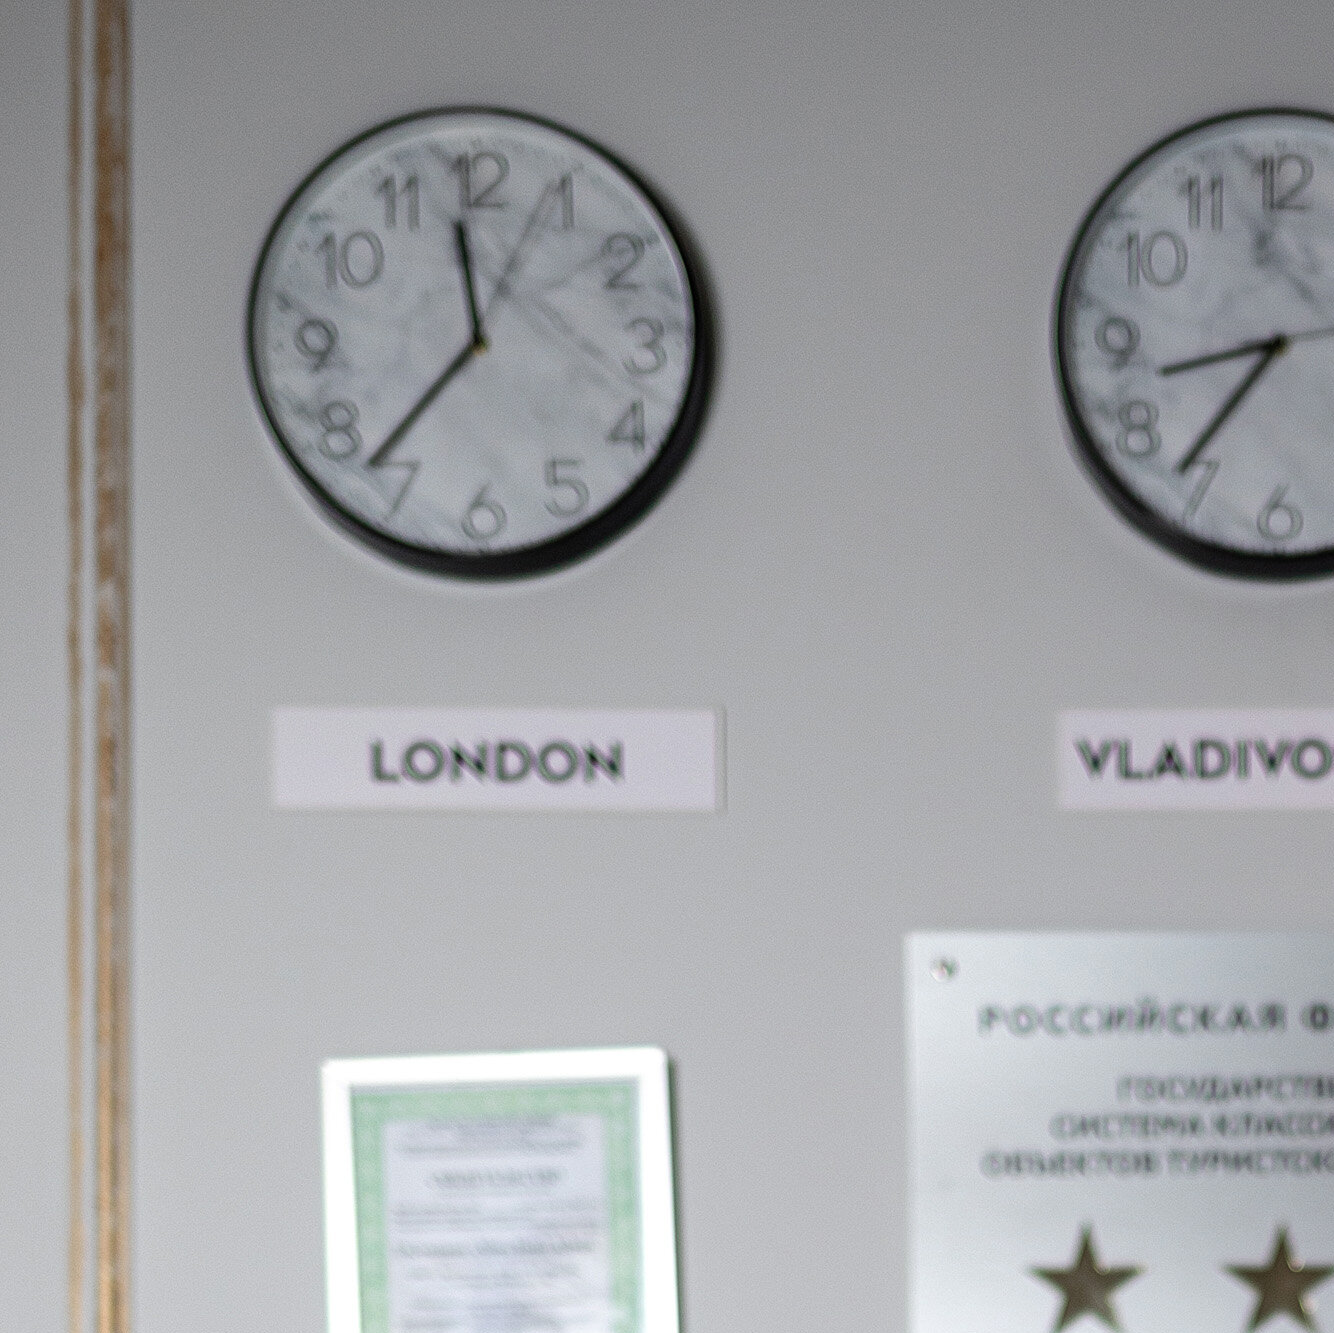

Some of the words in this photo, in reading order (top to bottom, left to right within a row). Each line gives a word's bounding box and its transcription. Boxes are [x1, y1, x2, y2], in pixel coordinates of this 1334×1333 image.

[377, 174, 420, 231] 11
[456, 151, 510, 209] 12
[552, 174, 574, 231] 1
[1181, 174, 1223, 231] 11
[1258, 153, 1313, 210] 12
[318, 230, 384, 290] 10
[606, 233, 645, 290] 2
[1123, 230, 1188, 287] 10
[296, 318, 338, 372] 9
[623, 318, 667, 375] 3
[1096, 317, 1140, 369] 9
[318, 401, 360, 461] 8
[607, 401, 646, 452] 4
[1116, 400, 1161, 459] 8
[373, 460, 420, 522] 7
[462, 485, 507, 540] 6
[544, 459, 590, 516] 5
[1180, 459, 1219, 520] 7
[1256, 484, 1303, 540] 6
[370, 738, 624, 784] LONDON
[977, 995, 1287, 1037] РОССИЙСКАЯ
